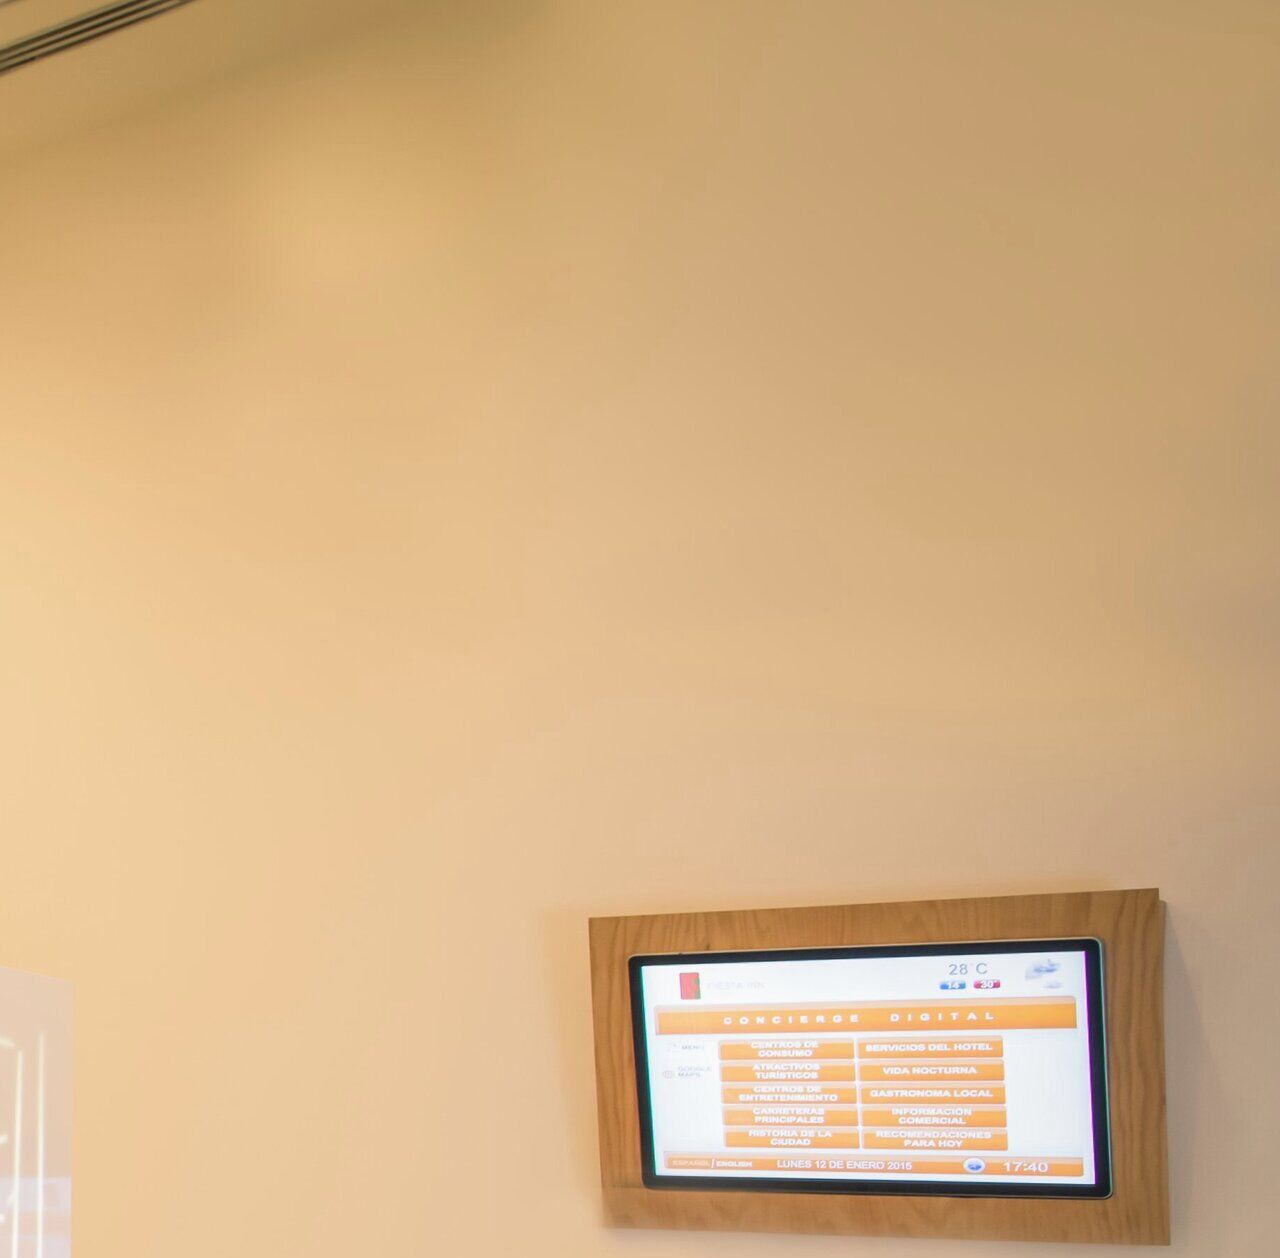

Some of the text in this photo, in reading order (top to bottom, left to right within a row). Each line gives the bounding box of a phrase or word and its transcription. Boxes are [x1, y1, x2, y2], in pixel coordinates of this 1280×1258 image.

[722, 1012, 995, 1025] CONCIERGE DIGITAL
[750, 1040, 820, 1049] CENTROS DE
[865, 1042, 994, 1052] SERVICIOS DEL HOTEL
[758, 1049, 813, 1057] CONSUMO
[752, 1063, 821, 1071] ATRACTIVOS
[882, 1066, 910, 1075] VIDA
[753, 1085, 822, 1093] CENTROS DE
[953, 1088, 994, 1098] LOCAL
[738, 1094, 839, 1102] ENTRETENIMIENTO
[752, 1107, 825, 1115] CARRETERAS
[754, 1116, 825, 1124] PRINCIPALES
[898, 1116, 967, 1125] COMERCIAL
[748, 1129, 832, 1138] HISTORIA DE LA
[875, 1130, 992, 1139] RECOMENDACIONES
[770, 1138, 811, 1146] CIUDAD
[903, 1139, 964, 1148] PARA HOY
[776, 1159, 813, 1169] LUNES
[815, 1159, 827, 1169] 12
[829, 1160, 844, 1169] DE
[845, 1160, 885, 1170] ENERO
[1002, 1161, 1049, 1173] 17:40
